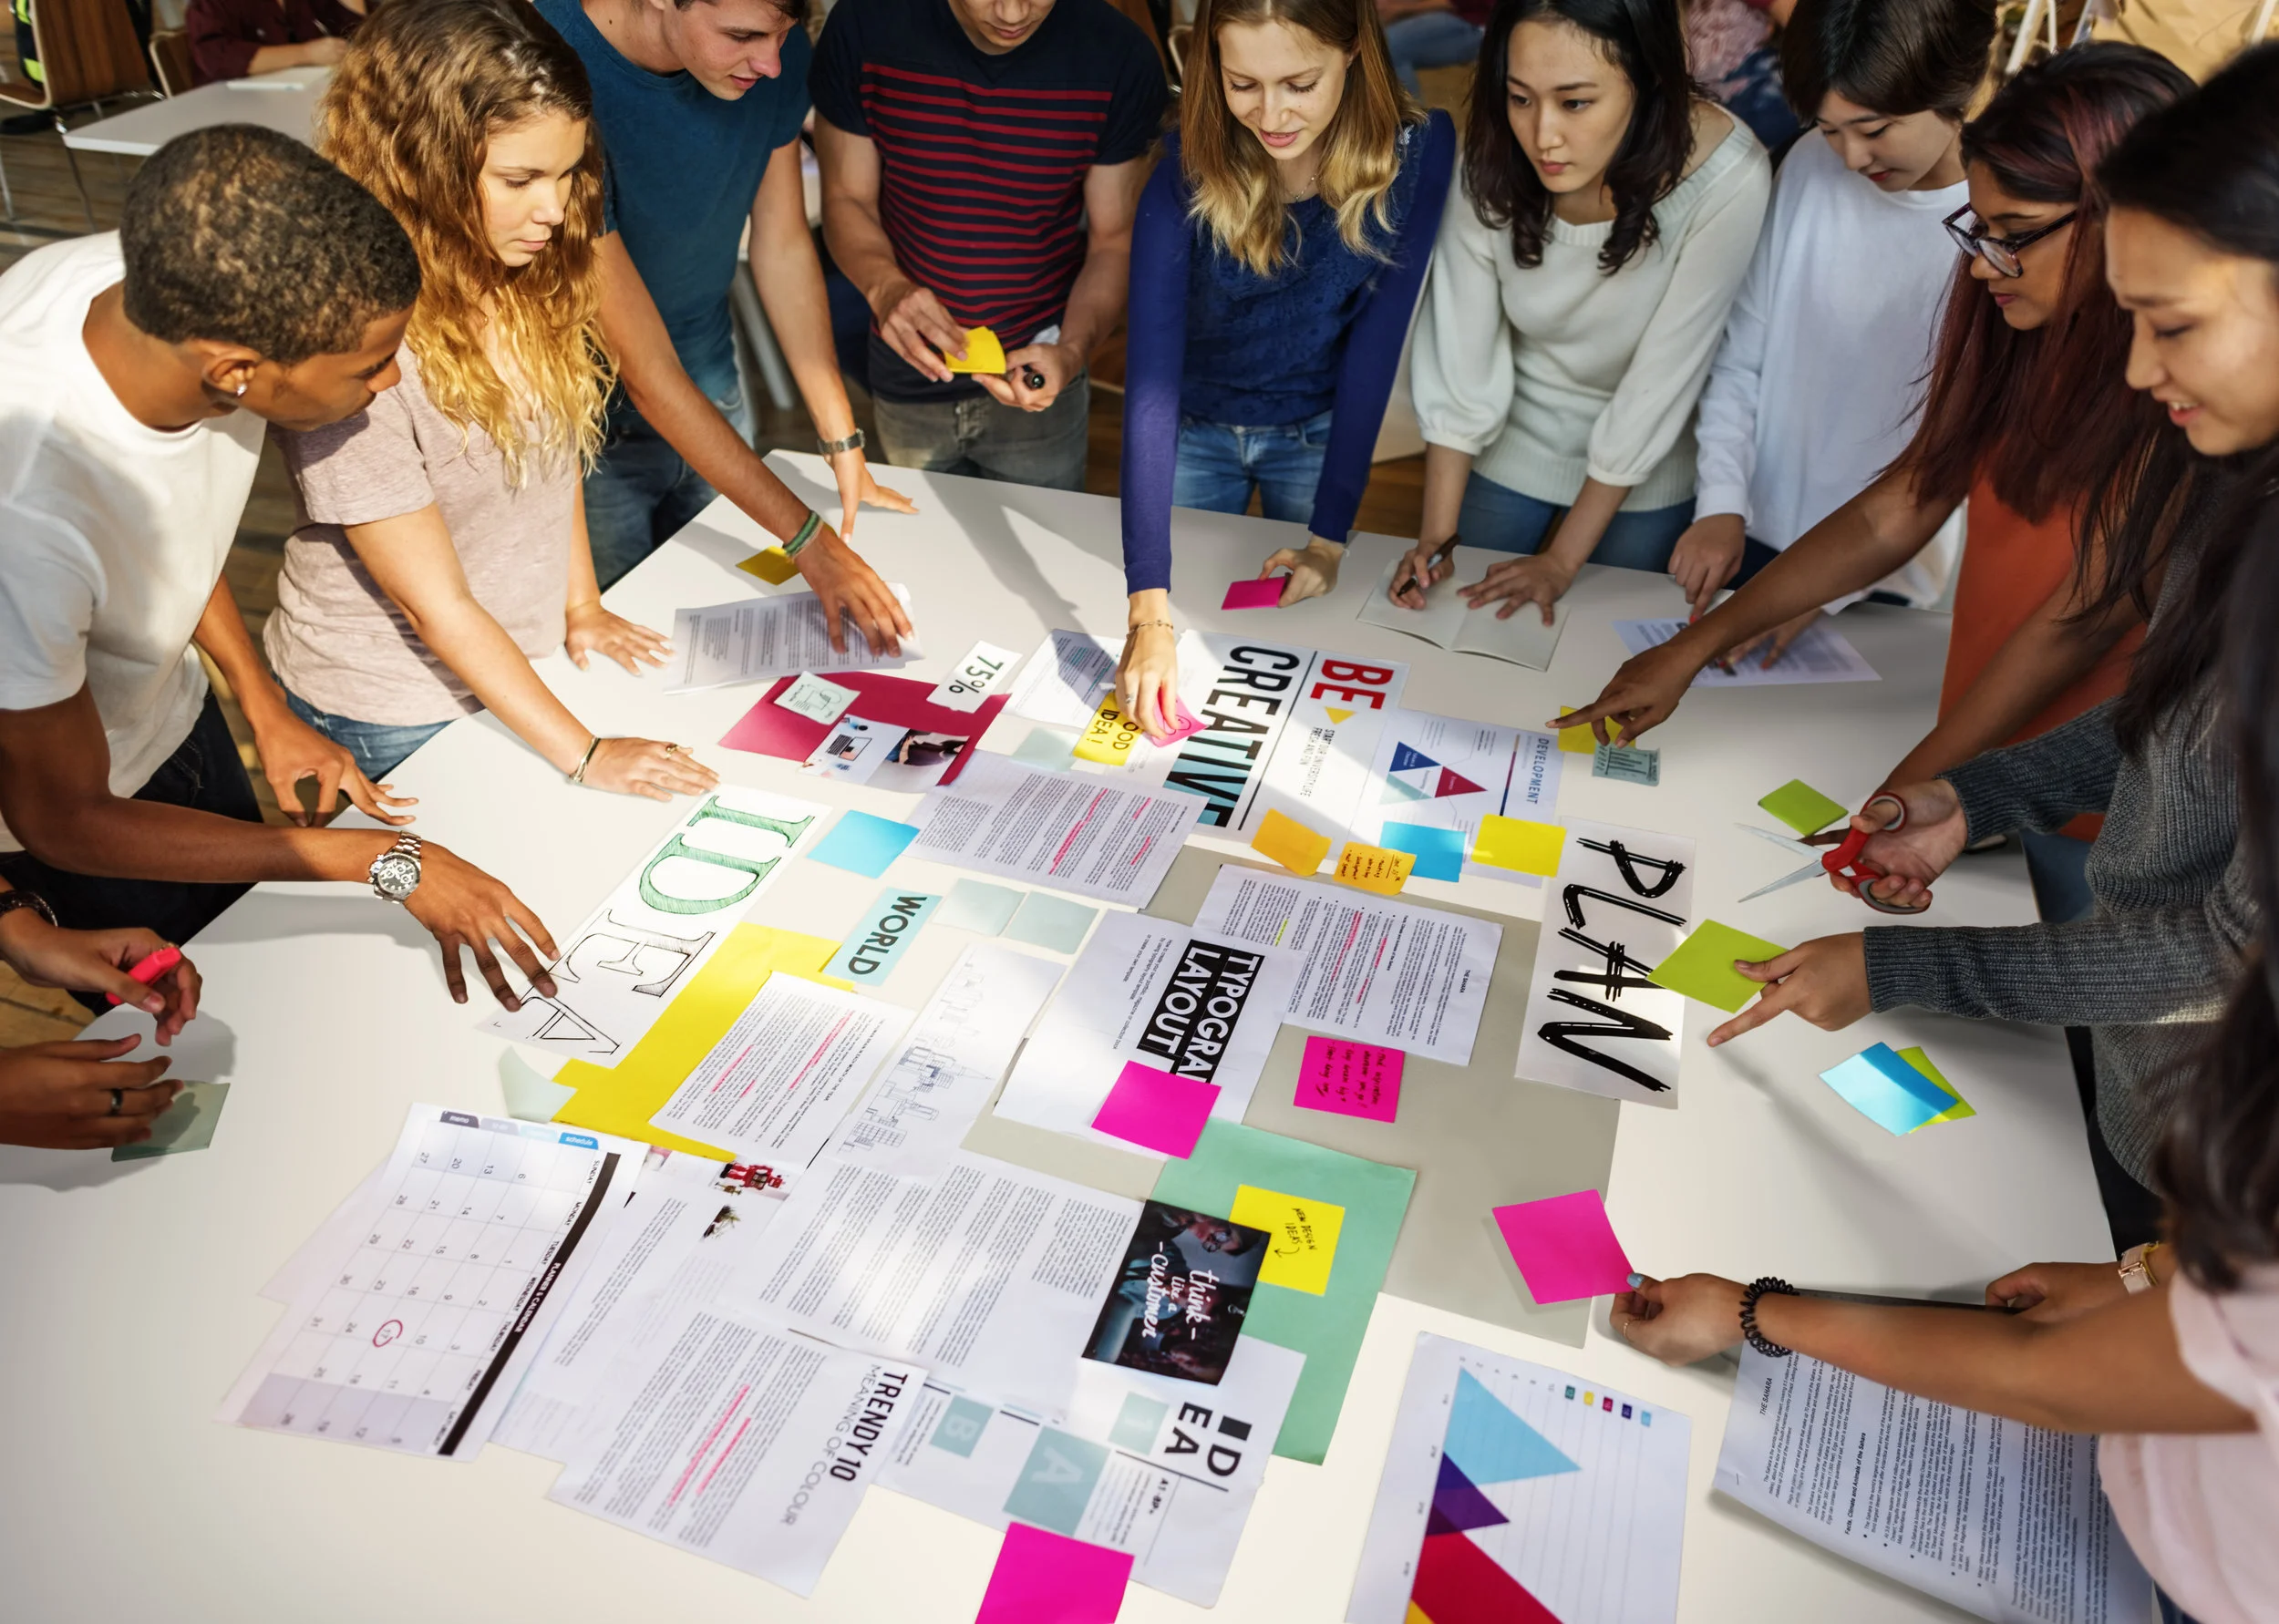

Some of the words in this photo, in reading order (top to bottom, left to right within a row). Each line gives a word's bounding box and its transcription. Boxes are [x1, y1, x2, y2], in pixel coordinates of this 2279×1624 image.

[949, 655, 1004, 694] 75%
[1310, 659, 1395, 710] BE
[1112, 721, 1140, 750] OOD
[1525, 737, 1550, 804] DEVELOPMENT
[497, 796, 815, 1054] IDEA
[848, 897, 927, 975] WORLD
[1538, 838, 1687, 1093] PLAN
[1459, 977, 1468, 993] SAHARA
[1147, 947, 1222, 1054] LAYOUT
[565, 1136, 593, 1146] schedule
[418, 1151, 429, 1163] 27
[450, 1157, 461, 1169] 20
[483, 1164, 493, 1175] 13
[584, 1159, 601, 1184] SUNDAY
[396, 1194, 407, 1206] 28
[428, 1199, 438, 1210] 21
[461, 1205, 471, 1216] 14
[562, 1200, 582, 1226] MONDAY
[402, 1238, 413, 1249] 22
[1284, 1222, 1303, 1244] IDEAS
[1301, 1225, 1317, 1249] DESIGN
[436, 1244, 446, 1255] 15
[540, 1239, 560, 1265] TUESDAY
[374, 1279, 385, 1291] 23
[538, 1261, 562, 1291] PLANNER
[1171, 1276, 1185, 1300] like
[407, 1284, 418, 1296] 16
[511, 1276, 538, 1311] WEDNESDAY
[1186, 1269, 1220, 1323] think
[476, 1299, 487, 1307] 2
[513, 1296, 541, 1332] CALENDAR
[1168, 1302, 1177, 1312] a
[345, 1321, 356, 1334] 24
[379, 1328, 390, 1339] 17
[415, 1333, 426, 1345] 10
[487, 1319, 512, 1352] THURSDAY
[449, 1343, 460, 1352] 3
[462, 1369, 482, 1392] FRIDAY
[1761, 1376, 1772, 1403] SAHARA
[833, 1362, 882, 1434] MEANING
[1758, 1402, 1768, 1415] THE
[842, 1366, 908, 1456] TRENDY
[945, 1415, 980, 1441] B
[819, 1434, 842, 1458] OF
[1858, 1431, 1867, 1451] Sahara
[828, 1454, 863, 1484] 10
[1032, 1447, 1085, 1483] A
[1855, 1457, 1862, 1465] of
[1851, 1465, 1861, 1487] Animals
[777, 1457, 829, 1531] COLOUR
[1847, 1496, 1856, 1518] Climate
